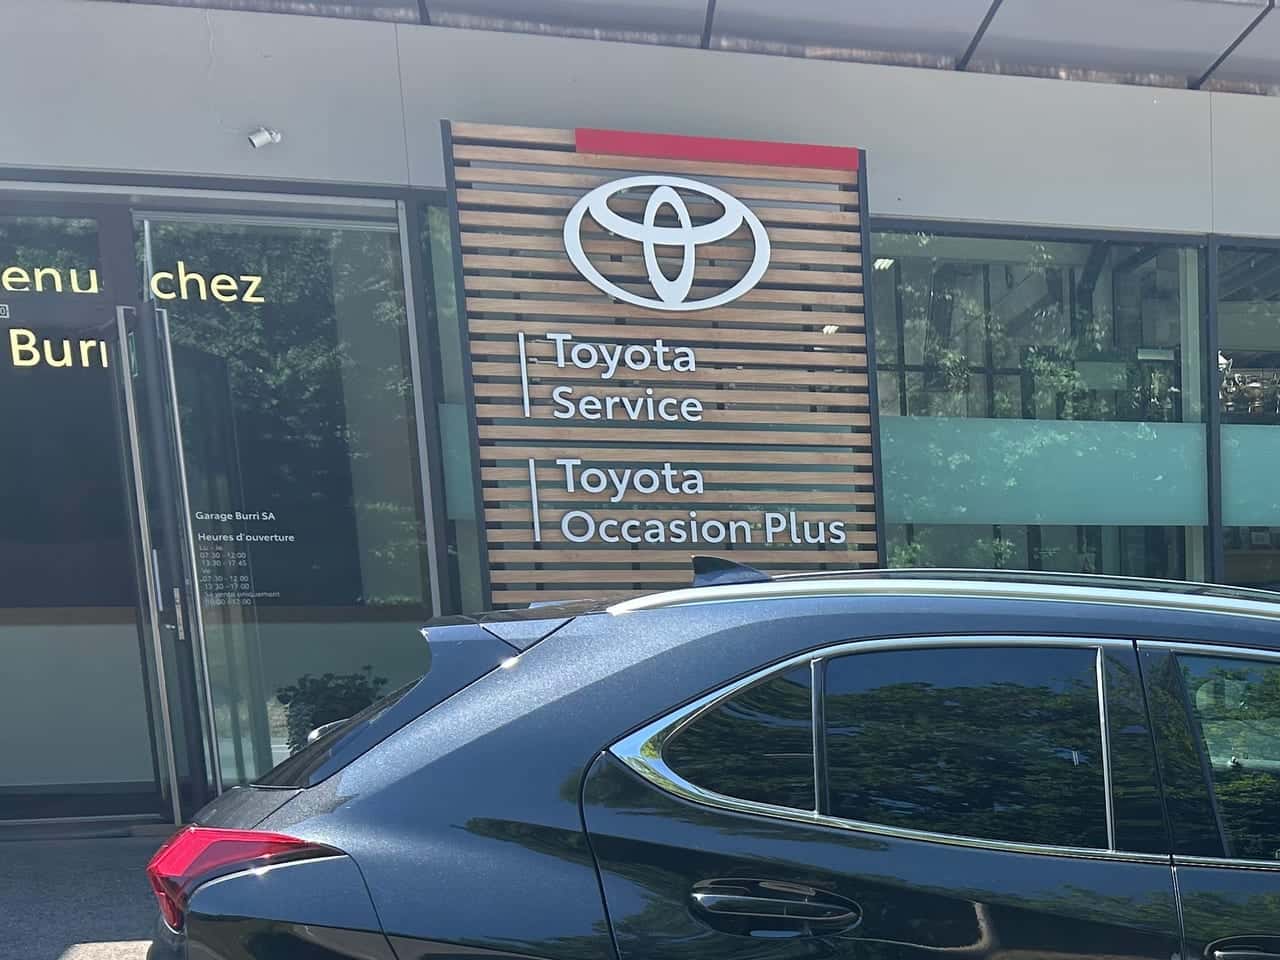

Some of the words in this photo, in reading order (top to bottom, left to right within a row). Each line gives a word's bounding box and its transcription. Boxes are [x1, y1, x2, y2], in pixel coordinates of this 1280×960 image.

[1, 265, 103, 293] enu
[150, 261, 265, 302] chez
[546, 332, 696, 378] Toyota
[552, 386, 703, 422] Service
[556, 458, 704, 502] Toyota
[195, 511, 233, 522] Garage
[235, 511, 260, 521] Burri
[261, 511, 276, 520] SA
[561, 510, 752, 544] Occasion
[764, 511, 847, 544] Plus
[198, 532, 234, 541] Heures
[236, 532, 295, 542] d'ouverture
